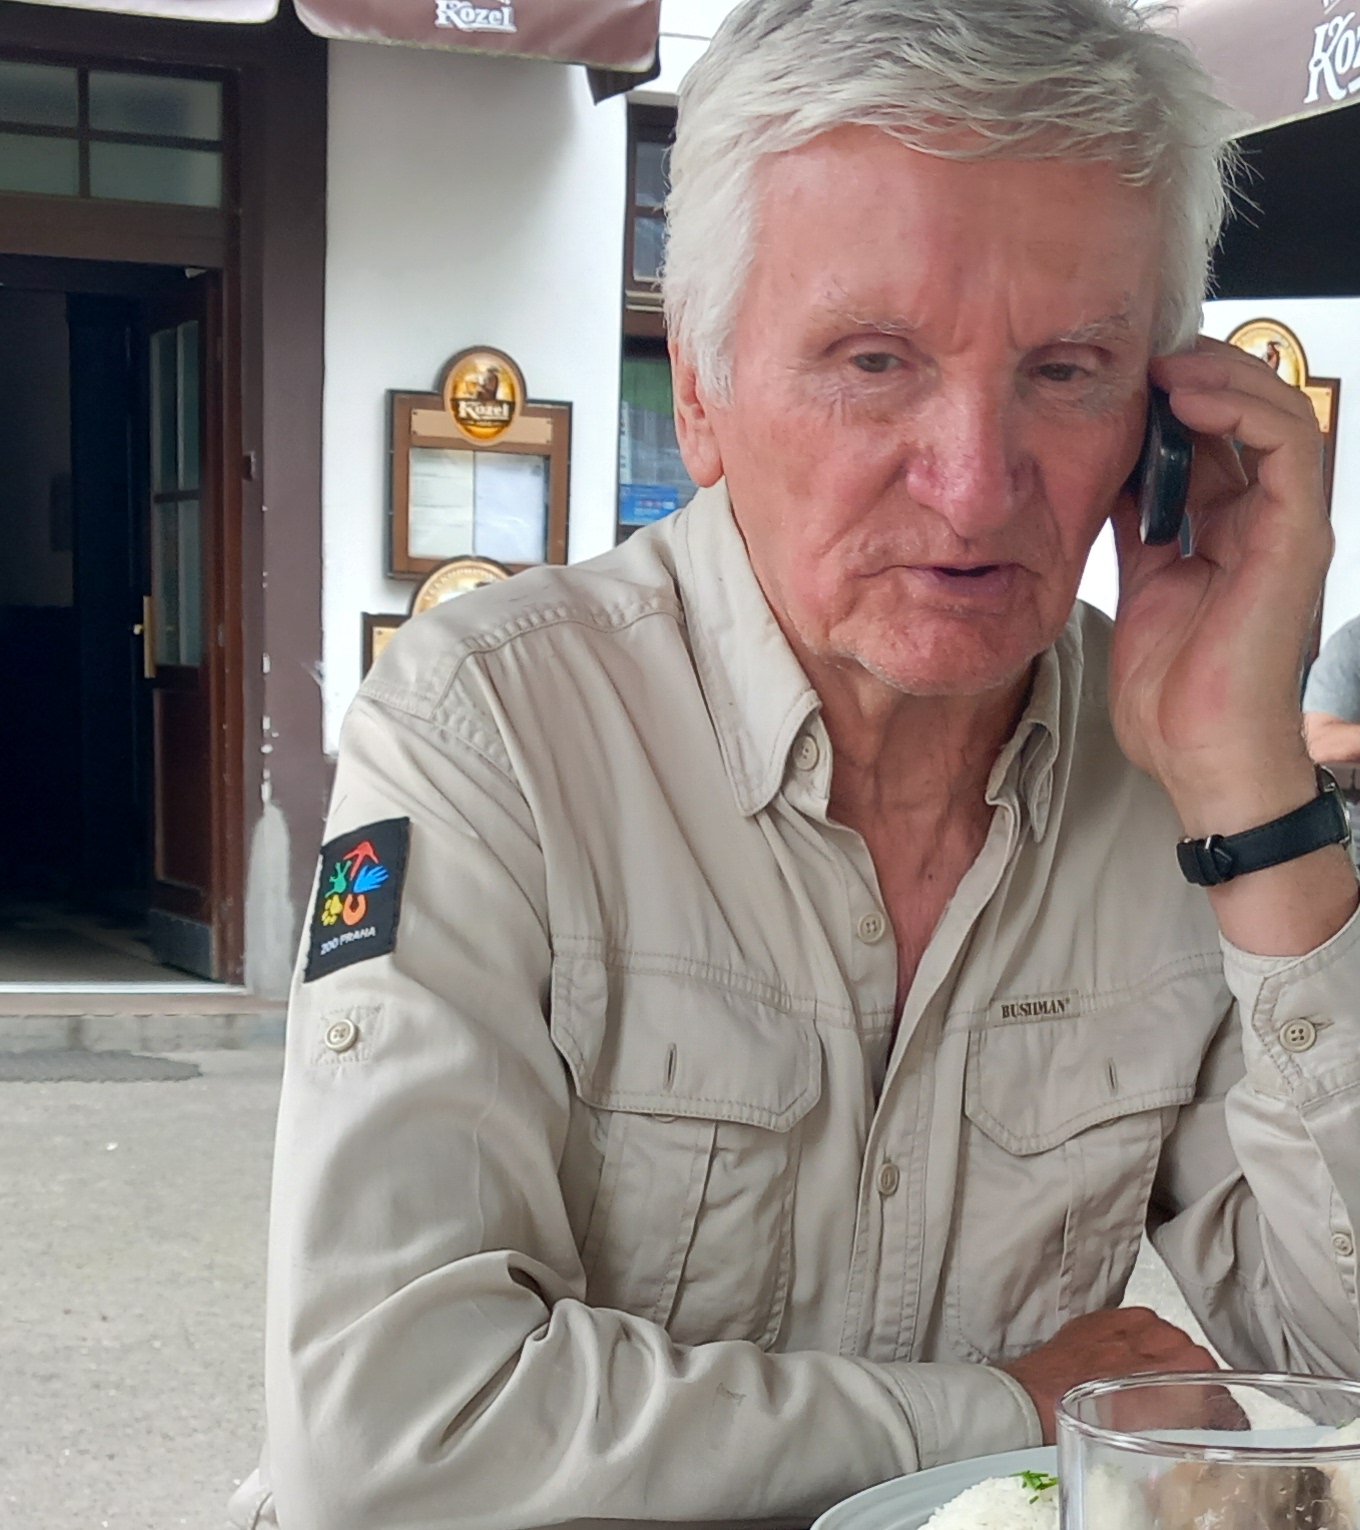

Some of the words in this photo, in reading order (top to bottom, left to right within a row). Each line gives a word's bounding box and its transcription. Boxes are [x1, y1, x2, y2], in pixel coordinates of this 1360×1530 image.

[458, 401, 509, 420] Kozel
[340, 926, 376, 945] PRAHA
[1001, 999, 1066, 1019] BUSHMAN
